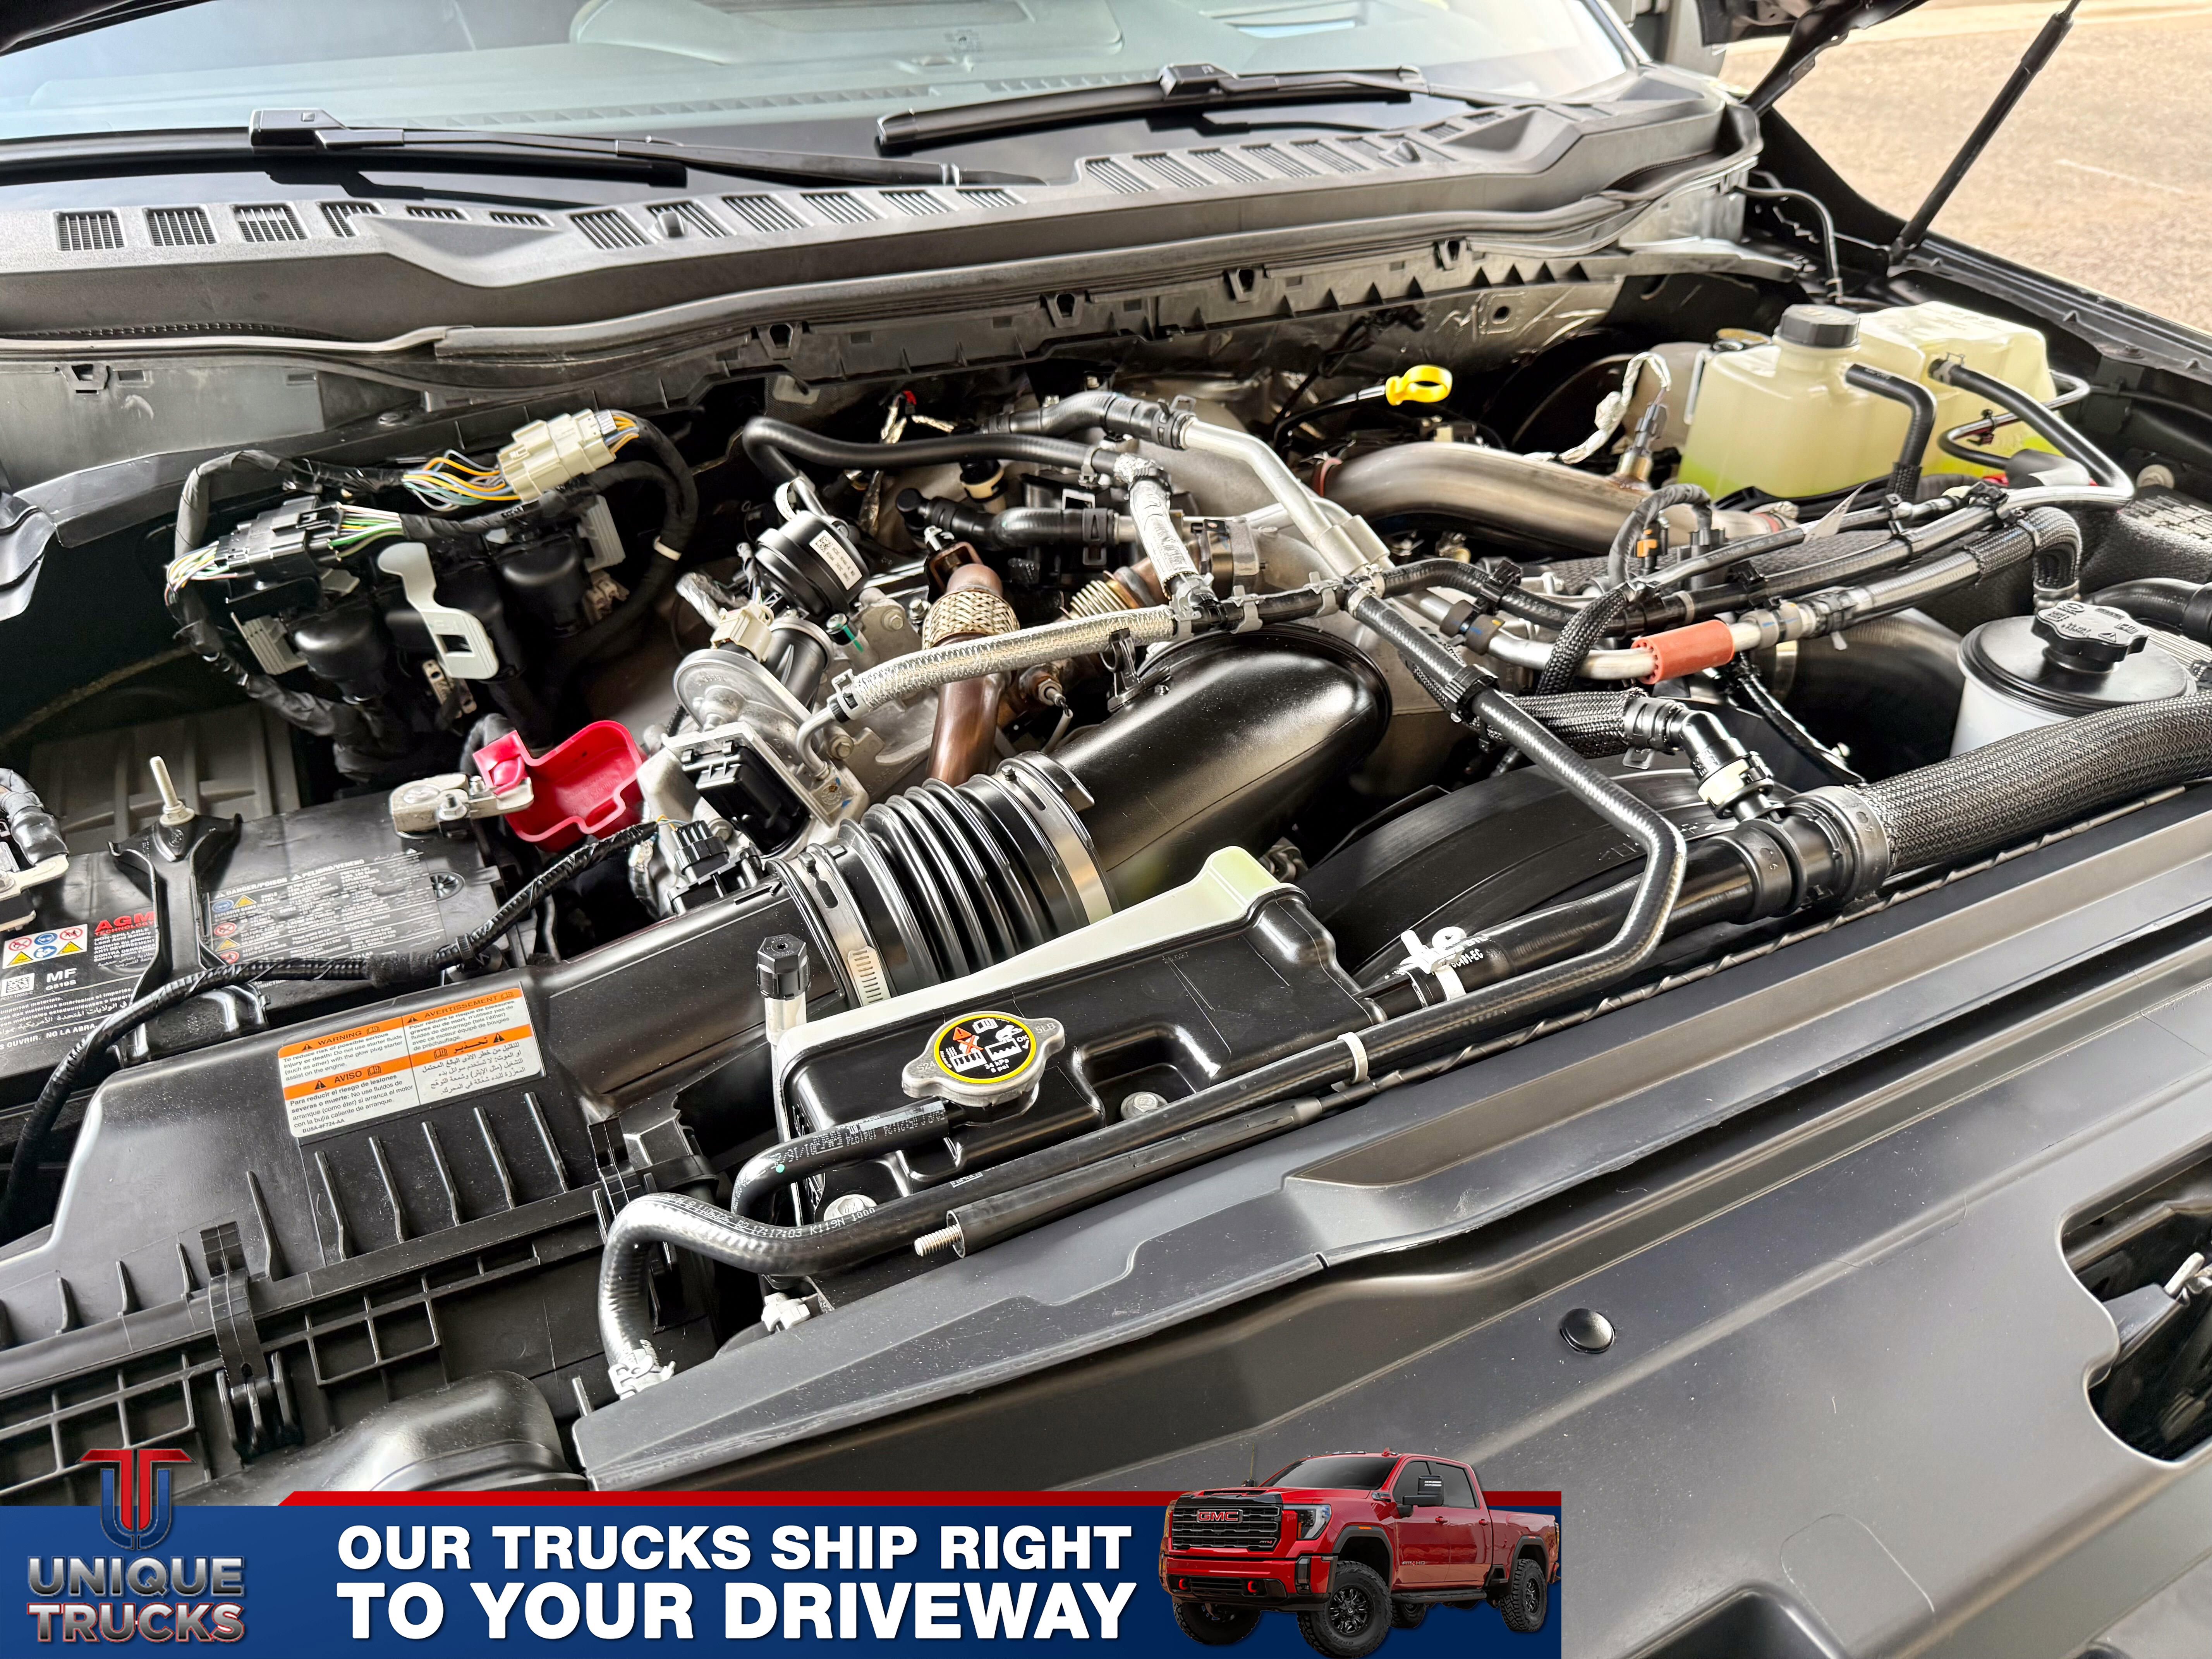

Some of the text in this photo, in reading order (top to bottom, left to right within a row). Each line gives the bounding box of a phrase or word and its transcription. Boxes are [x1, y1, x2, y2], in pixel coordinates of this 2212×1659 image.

[225, 877, 287, 896] DANGER/POISON
[93, 910, 156, 932] AGM
[94, 920, 154, 936] TECHNOLOGY
[45, 967, 78, 983] MF
[424, 996, 498, 1018] AVERTISSEMENT
[425, 1017, 447, 1025] réduire
[455, 1010, 475, 1018] risque
[485, 1000, 514, 1010] blessures
[410, 1026, 431, 1035] graves
[468, 1010, 493, 1019] n'utilisez
[411, 1031, 430, 1039] fluides
[440, 1020, 471, 1033] démarrage
[486, 1012, 505, 1021] l'éther)
[436, 1030, 456, 1039] moteur
[457, 1025, 477, 1034] équipé
[487, 1017, 510, 1026] bougies
[6, 1034, 41, 1048] OUVRIR.
[72, 1022, 98, 1033] ABRA.
[292, 1051, 315, 1060] reduce
[337, 1038, 364, 1049] possible
[365, 1032, 388, 1041] serious
[318, 1030, 362, 1046] WARNING
[422, 1035, 462, 1049] préchauffage.
[285, 1066, 301, 1075] (such
[384, 1041, 403, 1049] starter
[312, 1052, 332, 1061] death:
[367, 1038, 385, 1047] starter
[285, 1072, 303, 1081] assist
[325, 1061, 347, 1072] engine.
[334, 1070, 362, 1083] AVISO
[290, 1098, 305, 1106] Para
[307, 1091, 330, 1102] reducir
[339, 1084, 359, 1094] riesgo
[370, 1074, 397, 1085] lesiones
[291, 1103, 317, 1113] severas
[325, 1094, 350, 1104] muerte:
[374, 1082, 393, 1091] fluidos
[293, 1109, 321, 1121] arranque
[322, 1103, 341, 1113] (como
[342, 1099, 357, 1108] éter)
[365, 1092, 388, 1101] arranca
[396, 1085, 413, 1093] motor
[330, 1108, 354, 1118] caliente
[365, 1098, 393, 1110] arranque.
